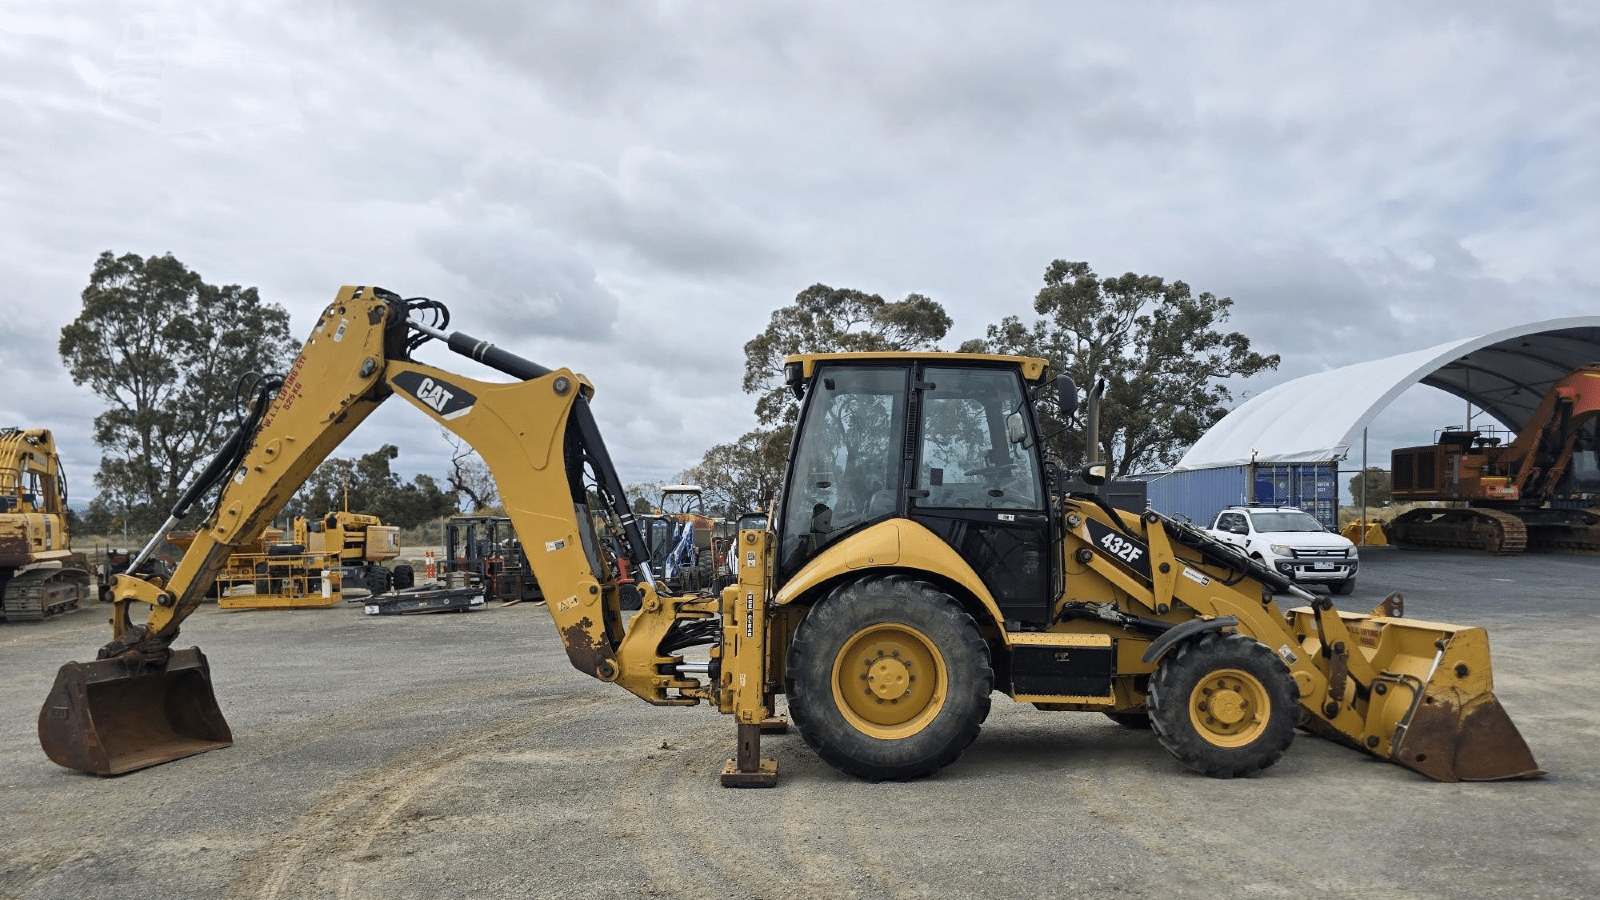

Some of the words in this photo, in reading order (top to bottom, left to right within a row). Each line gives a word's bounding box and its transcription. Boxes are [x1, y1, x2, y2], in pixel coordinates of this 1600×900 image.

[278, 370, 299, 400] LIFTING
[296, 354, 306, 369] EYE
[416, 377, 454, 412] CAT
[1100, 532, 1143, 563] 432F
